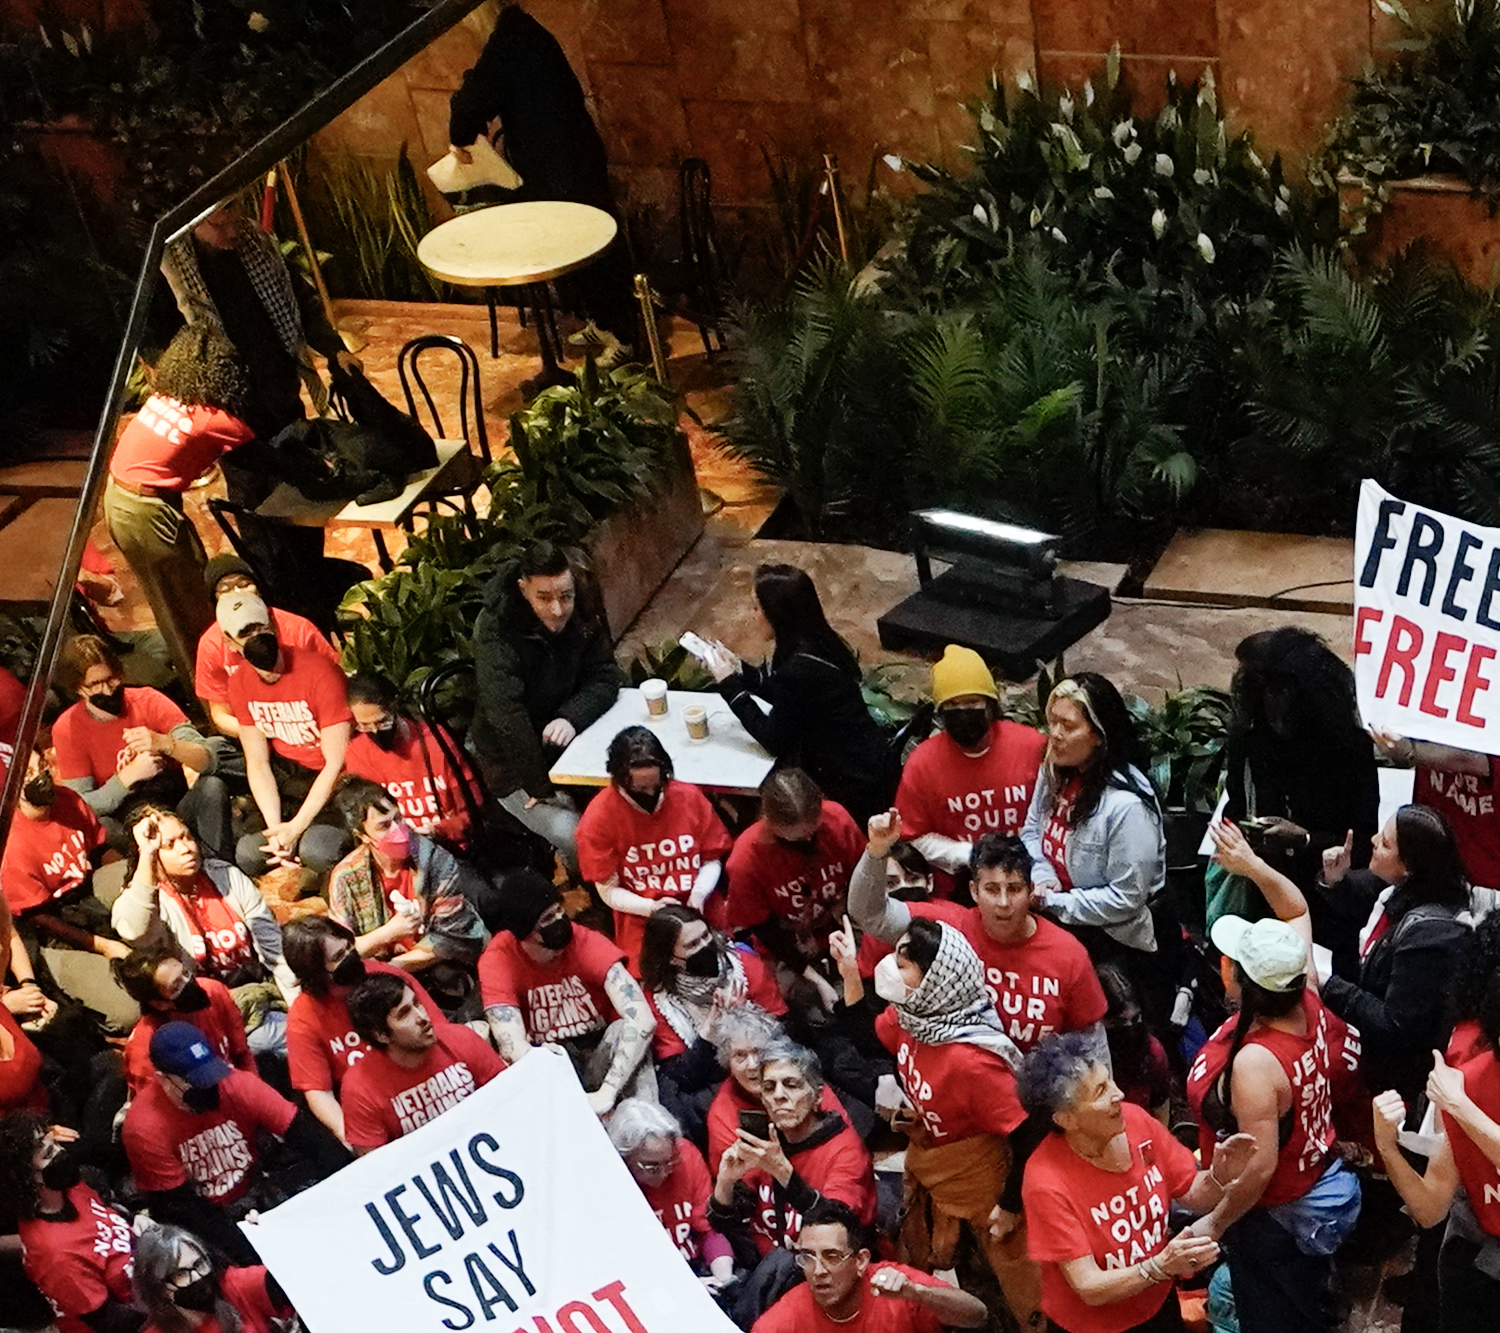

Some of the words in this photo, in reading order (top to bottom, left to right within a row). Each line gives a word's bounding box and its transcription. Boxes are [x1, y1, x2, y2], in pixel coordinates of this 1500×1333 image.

[1356, 606, 1497, 728] FREE
[424, 775, 447, 794] IN
[948, 790, 999, 812] NOT
[1005, 783, 1027, 803] IN
[964, 807, 1019, 831] OUR
[626, 835, 696, 864] STOP
[1032, 975, 1060, 998] IN
[392, 1062, 474, 1117] VETERANS
[364, 1132, 525, 1276] JEWS
[1090, 1186, 1139, 1228] NOT
[1143, 1164, 1164, 1190] IN
[1111, 1193, 1164, 1239] OUR
[423, 1230, 536, 1331] SAY
